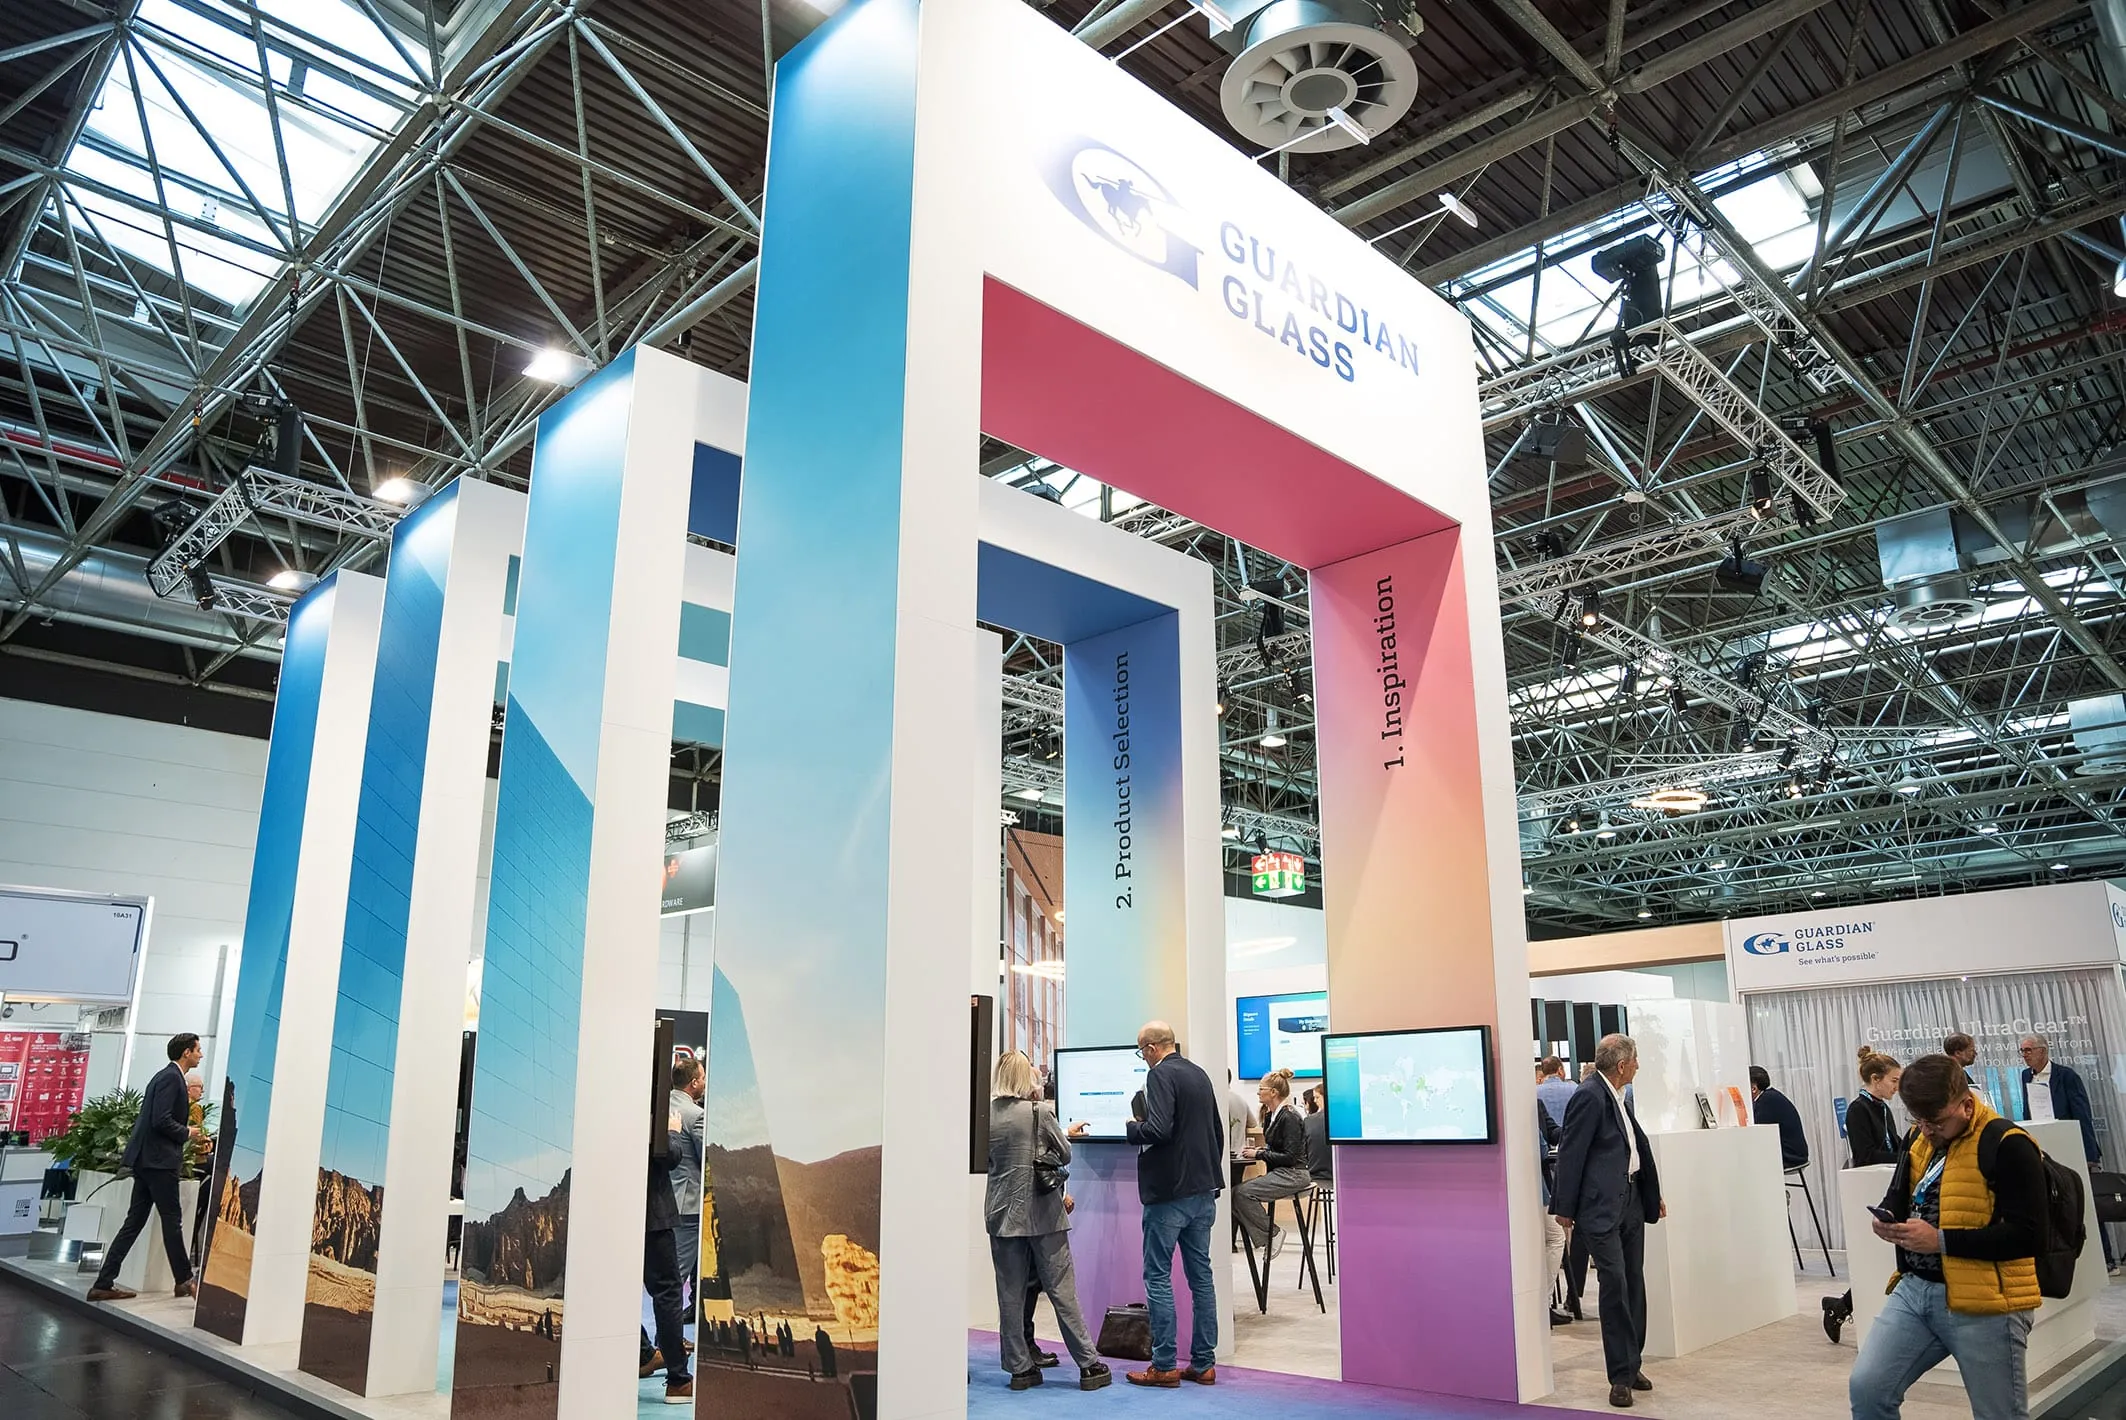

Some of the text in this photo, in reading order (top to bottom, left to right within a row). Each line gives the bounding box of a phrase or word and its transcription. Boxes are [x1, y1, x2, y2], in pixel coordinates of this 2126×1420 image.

[1220, 221, 1419, 377] GUARDIAN
[1222, 275, 1355, 383] GLASS
[1373, 575, 1406, 770] 1. Inspiration
[1113, 650, 1132, 909] 2. Product Selection
[1794, 922, 1873, 939] GUARDIAN
[1796, 938, 1844, 952] GLASS
[1798, 958, 1813, 966] See
[1814, 955, 1841, 964] what's
[1866, 1023, 1955, 1042] Guardian
[1873, 1045, 1922, 1056] ow-iron
[2059, 1037, 2093, 1049] from
